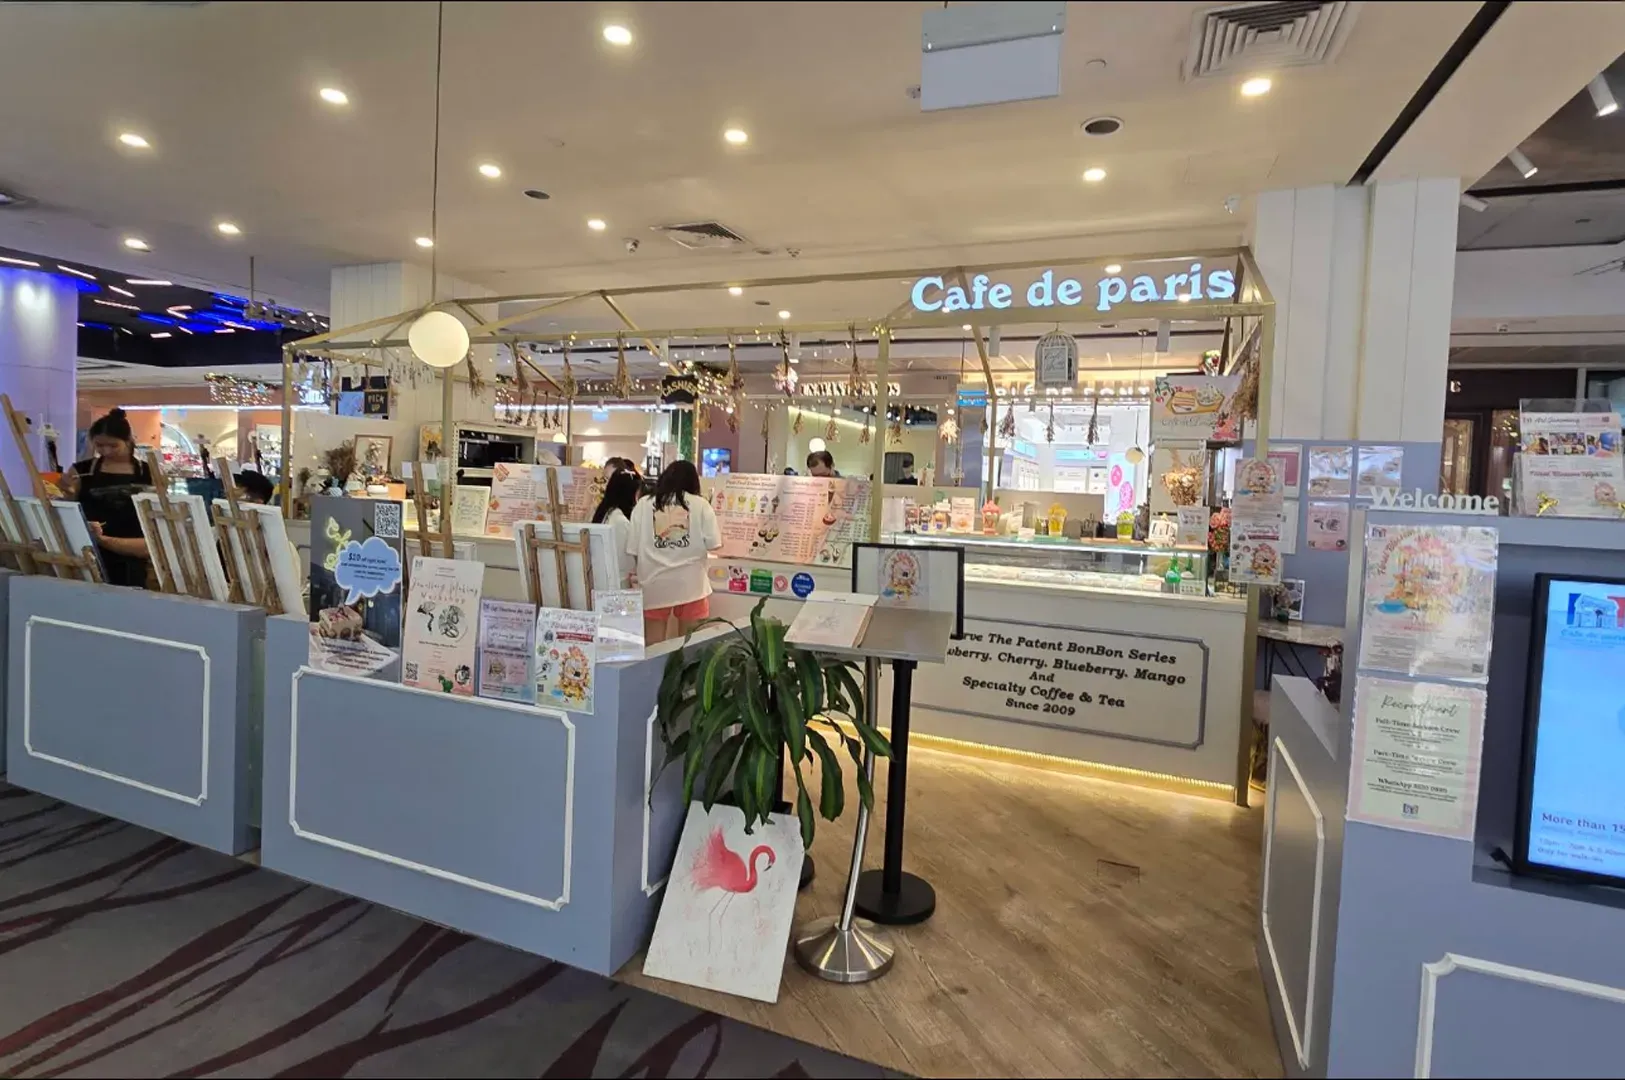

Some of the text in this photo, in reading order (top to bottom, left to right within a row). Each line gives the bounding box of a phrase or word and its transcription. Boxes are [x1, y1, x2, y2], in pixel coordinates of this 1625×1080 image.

[912, 263, 1237, 312] Cafe de paris
[662, 379, 698, 397] CASHIER
[367, 394, 385, 404] PICK
[1369, 486, 1499, 514] Welcome
[988, 632, 1013, 646] The
[1016, 636, 1063, 652] Patent
[1067, 642, 1123, 658] BonBon
[1128, 649, 1177, 664] Series
[1029, 671, 1055, 683] And
[1134, 668, 1186, 686] Mango
[962, 675, 1126, 708] Specialty Coffee & Tea
[1005, 697, 1076, 716] Since 2009
[1541, 812, 1573, 826] More
[1577, 818, 1606, 831] than
